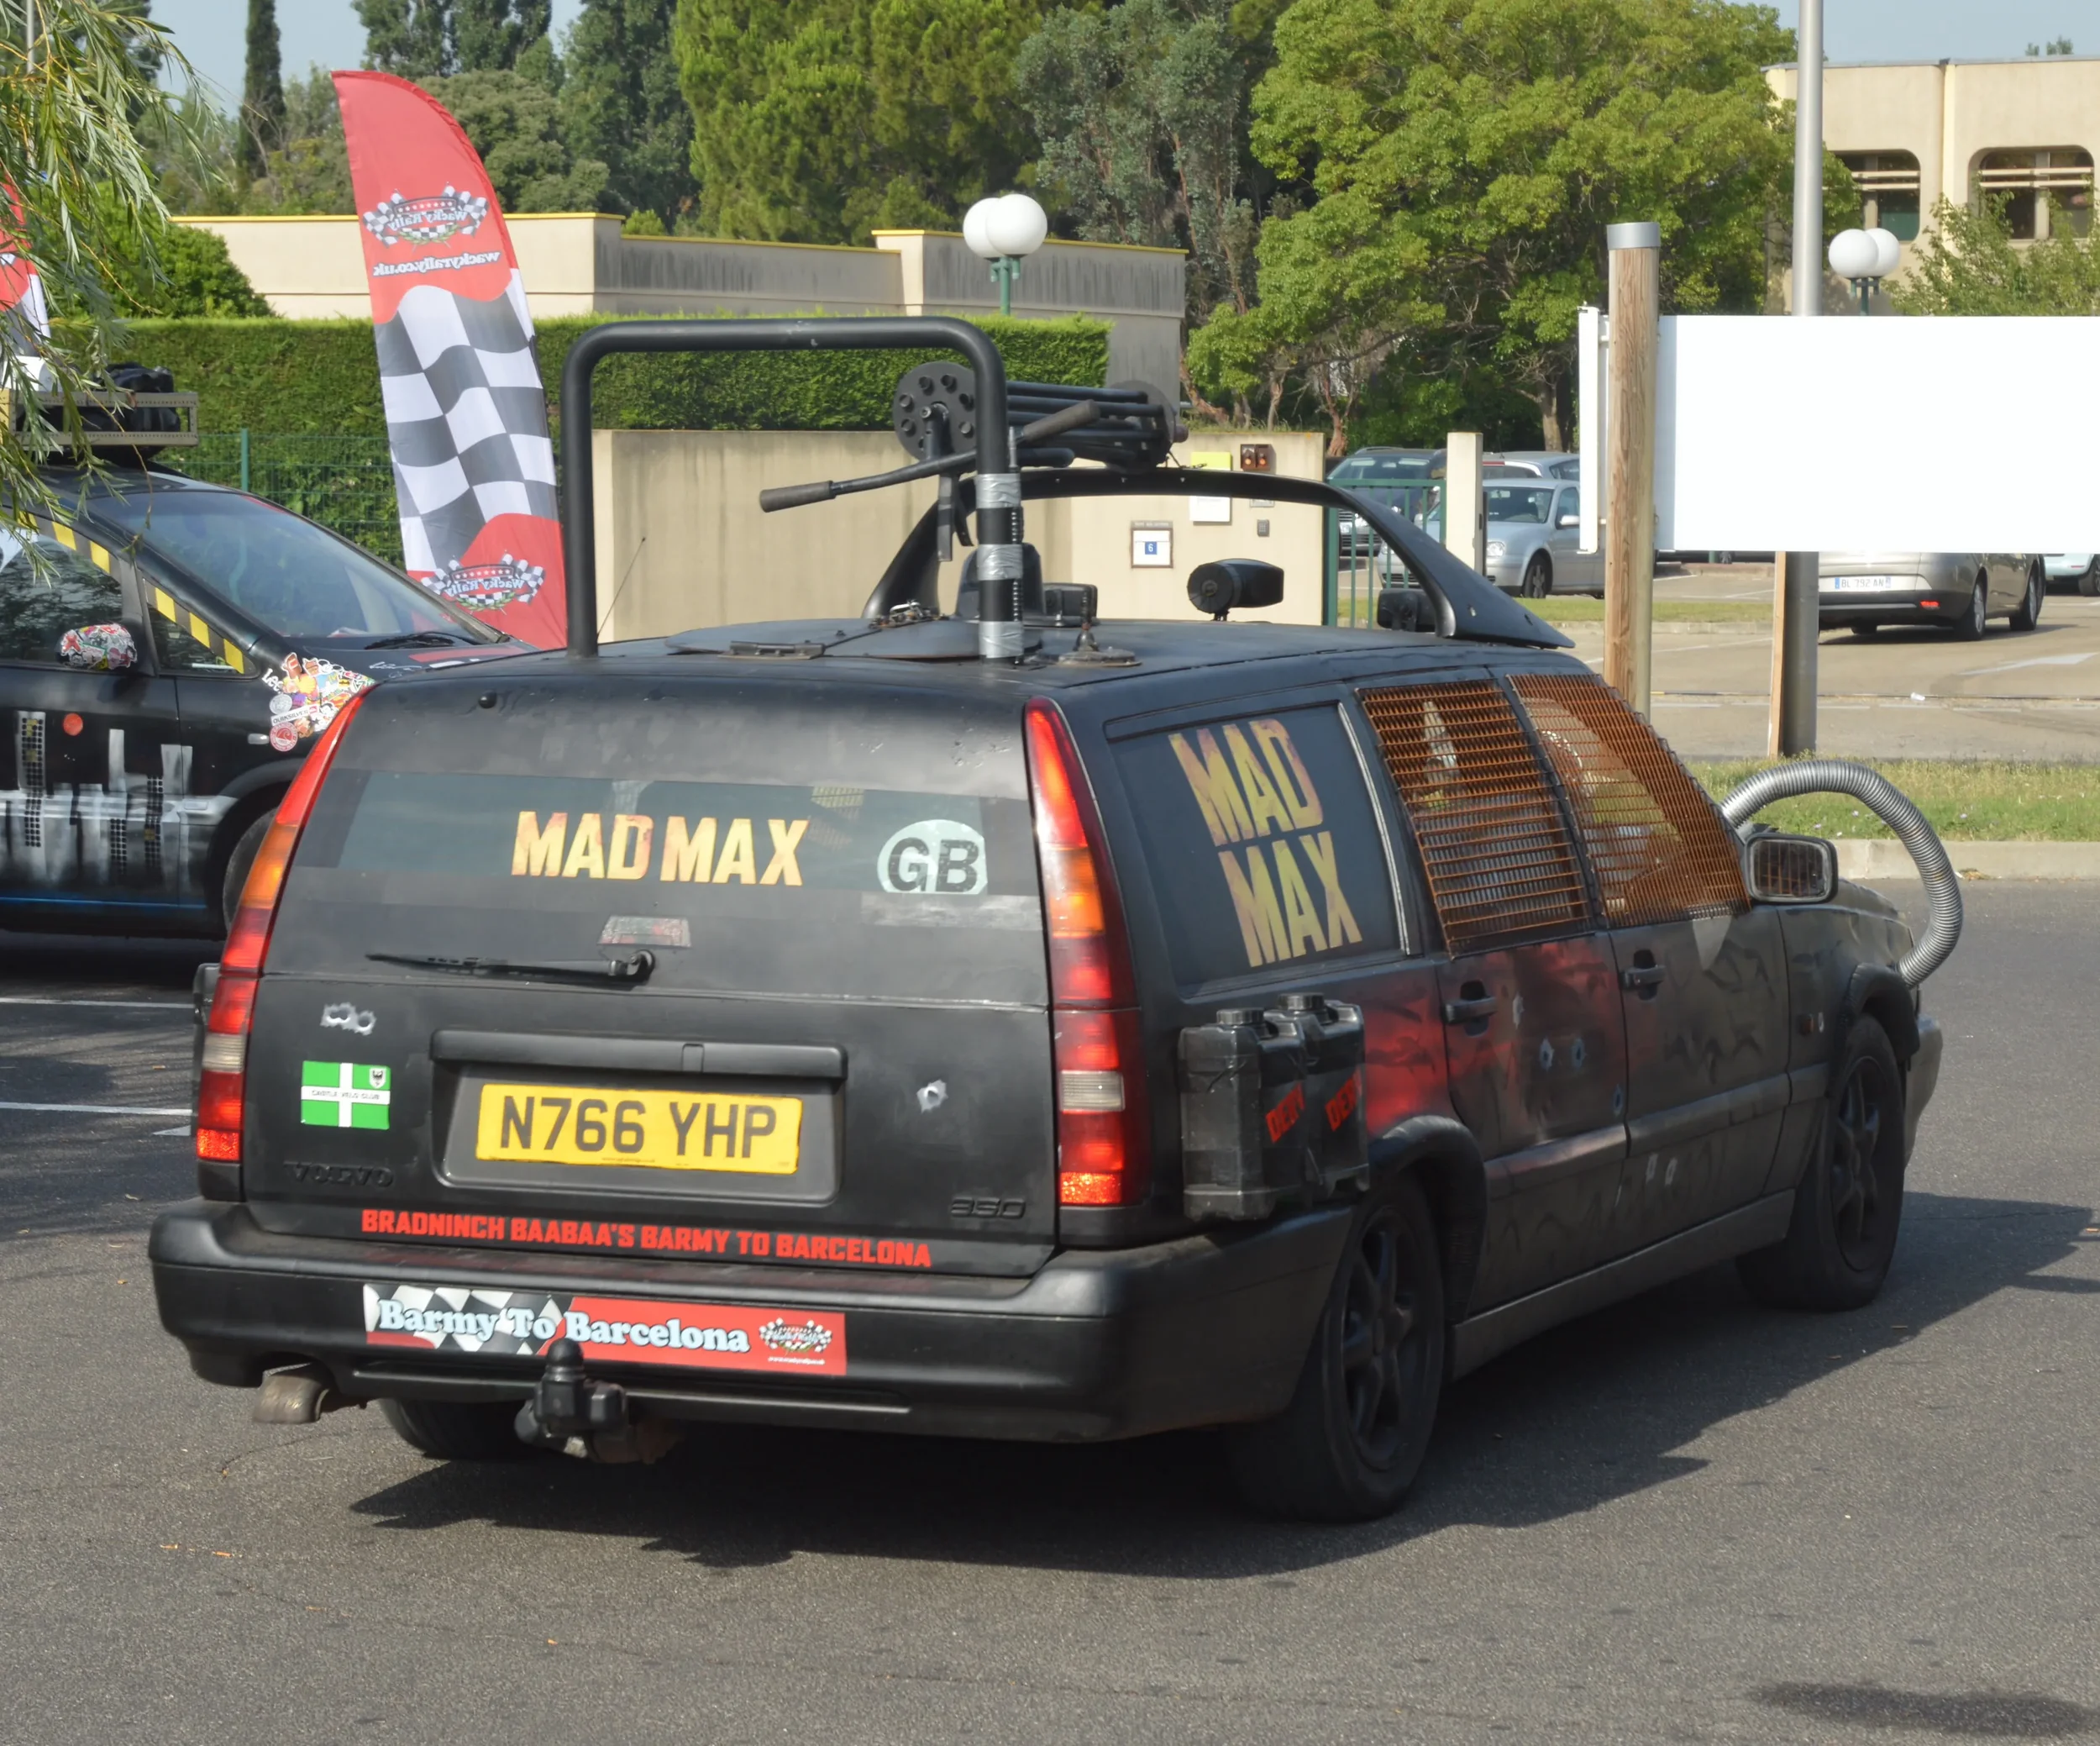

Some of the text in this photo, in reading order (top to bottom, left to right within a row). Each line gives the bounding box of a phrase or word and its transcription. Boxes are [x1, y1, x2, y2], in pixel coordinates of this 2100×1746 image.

[262, 668, 284, 692] Lee
[1168, 718, 1324, 847] MAD
[511, 810, 811, 886] MAD MAX
[887, 837, 980, 894] GB
[1218, 830, 1362, 968] MAX
[500, 1096, 777, 1159] N766 YHP
[283, 1160, 395, 1188] VOLVO
[361, 1209, 932, 1268] BRADNINCH BAABAA'S BARMY TO BARCELONA
[378, 1299, 751, 1353] Barmy To Barcelona
